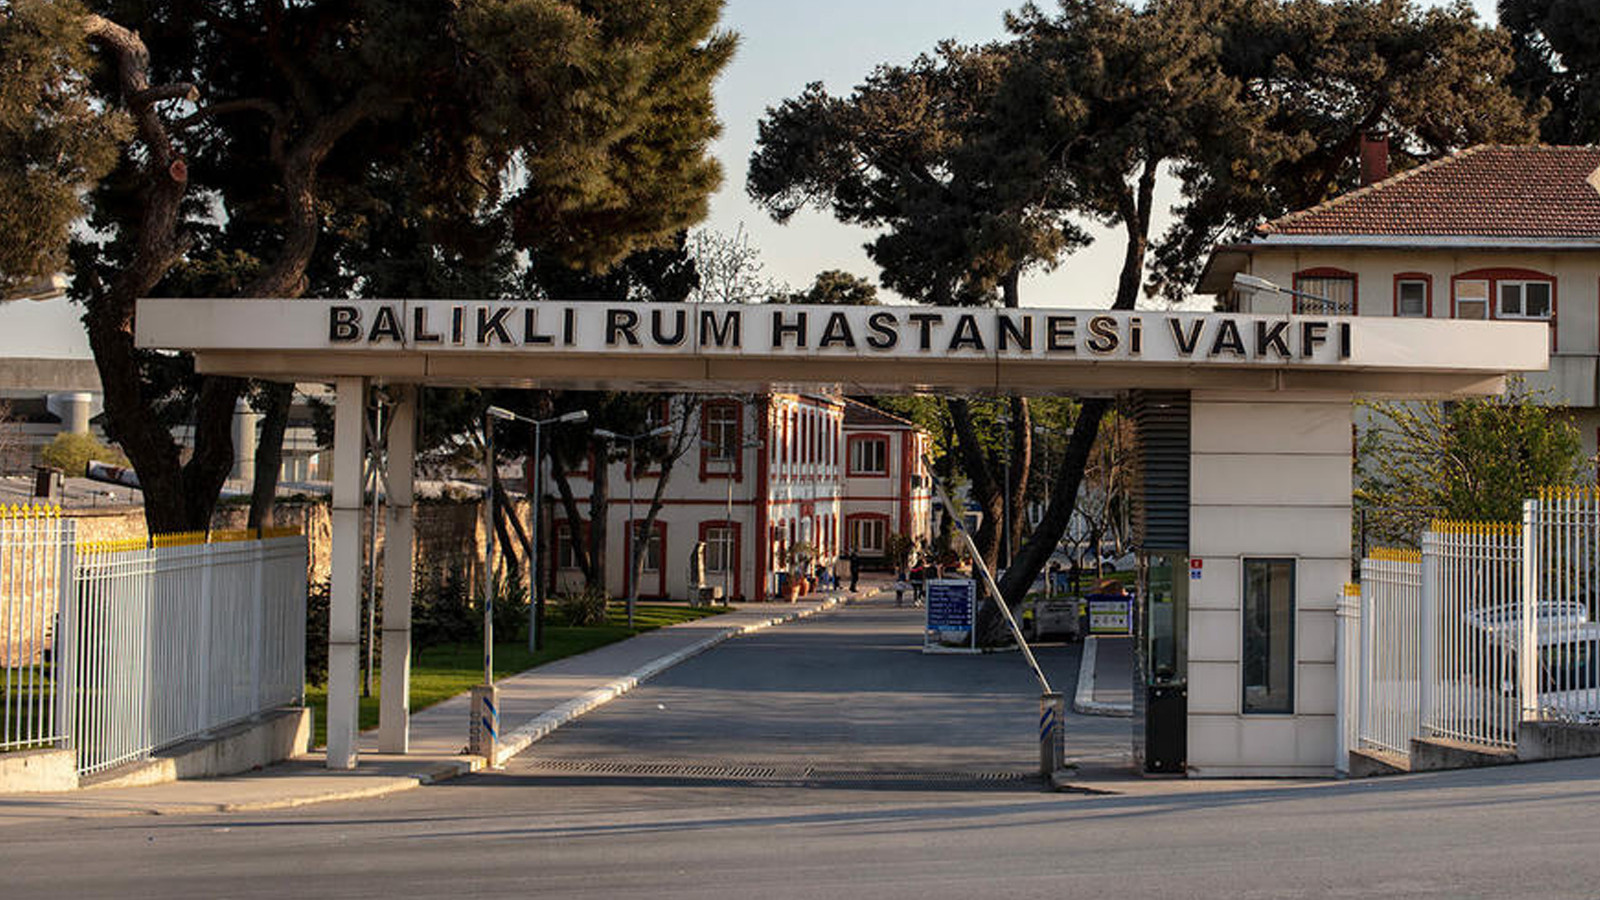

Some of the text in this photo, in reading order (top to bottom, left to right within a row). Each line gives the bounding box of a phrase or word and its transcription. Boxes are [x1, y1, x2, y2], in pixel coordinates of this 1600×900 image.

[329, 306, 574, 346] BALIKLI
[606, 309, 742, 348] RUM
[1173, 318, 1352, 359] VAKFI
